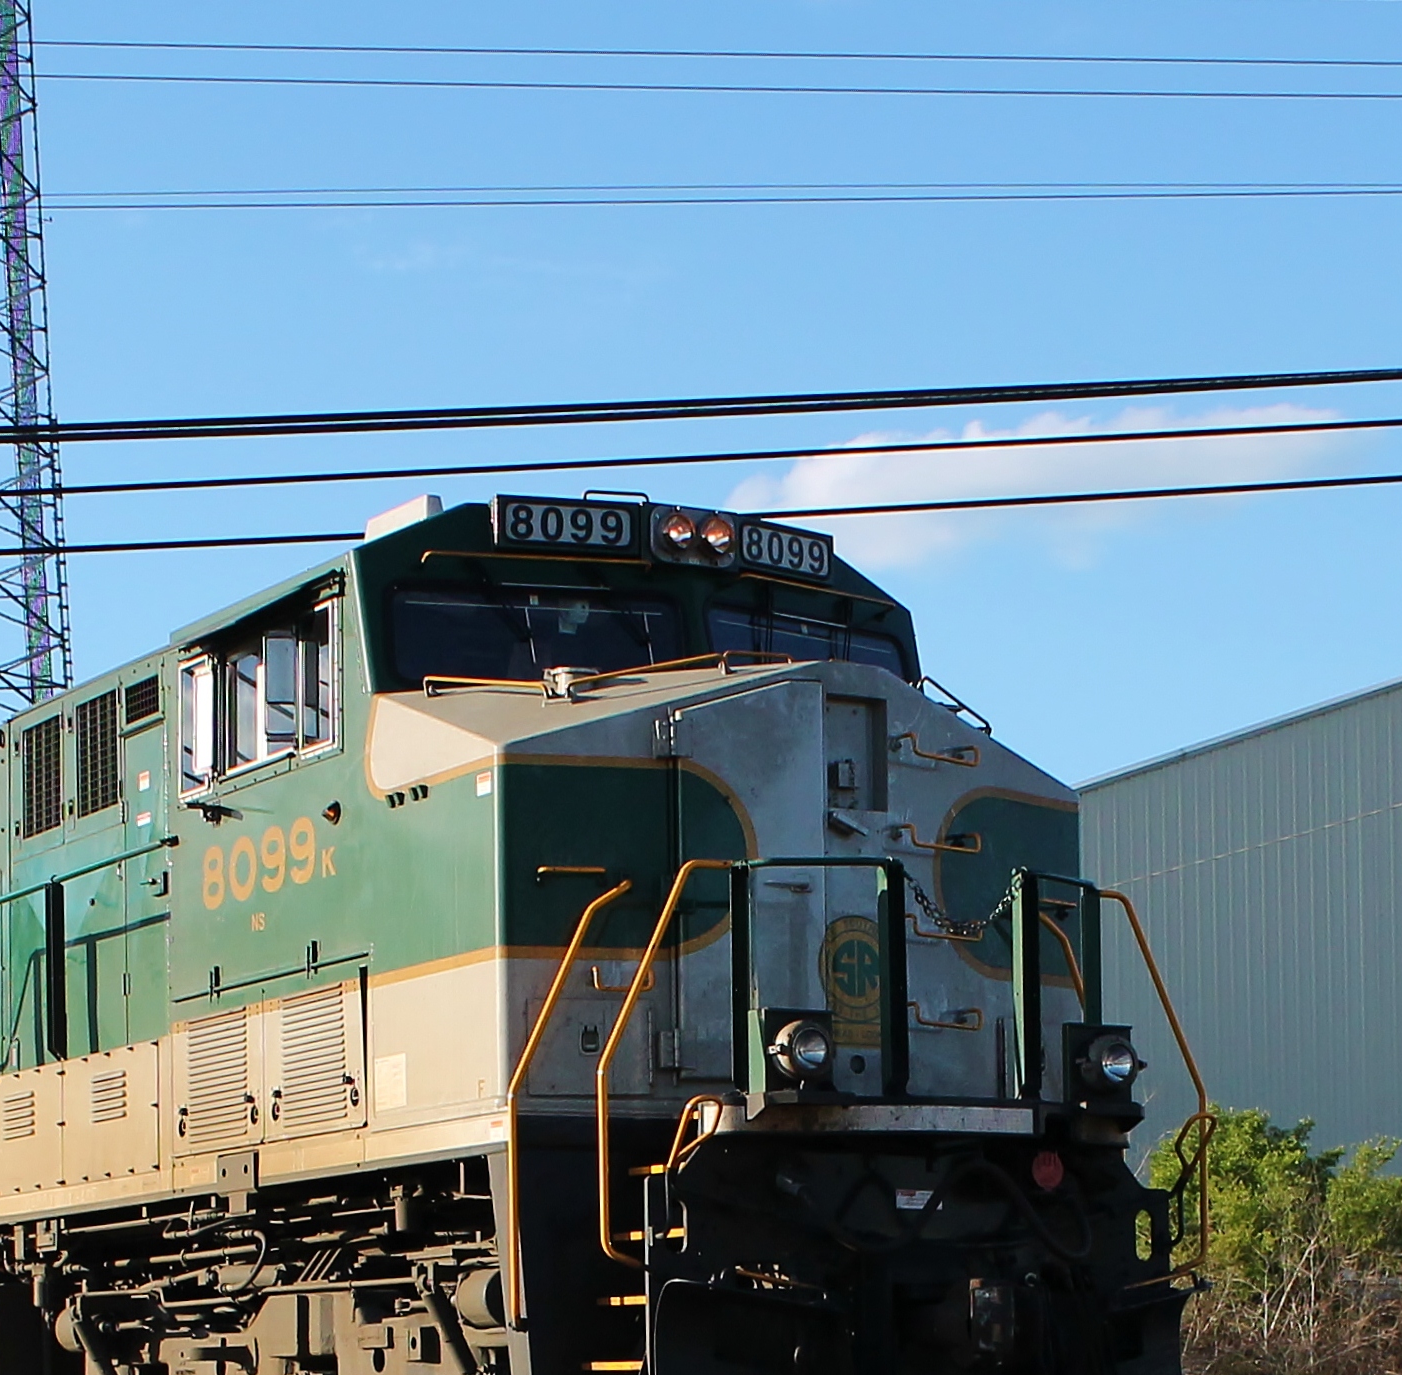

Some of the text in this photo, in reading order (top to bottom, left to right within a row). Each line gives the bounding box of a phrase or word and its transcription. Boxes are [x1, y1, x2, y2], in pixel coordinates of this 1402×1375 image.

[510, 504, 624, 545] 8099
[746, 527, 826, 576] 8099
[202, 816, 337, 911] 8099 K
[251, 912, 265, 932] NS
